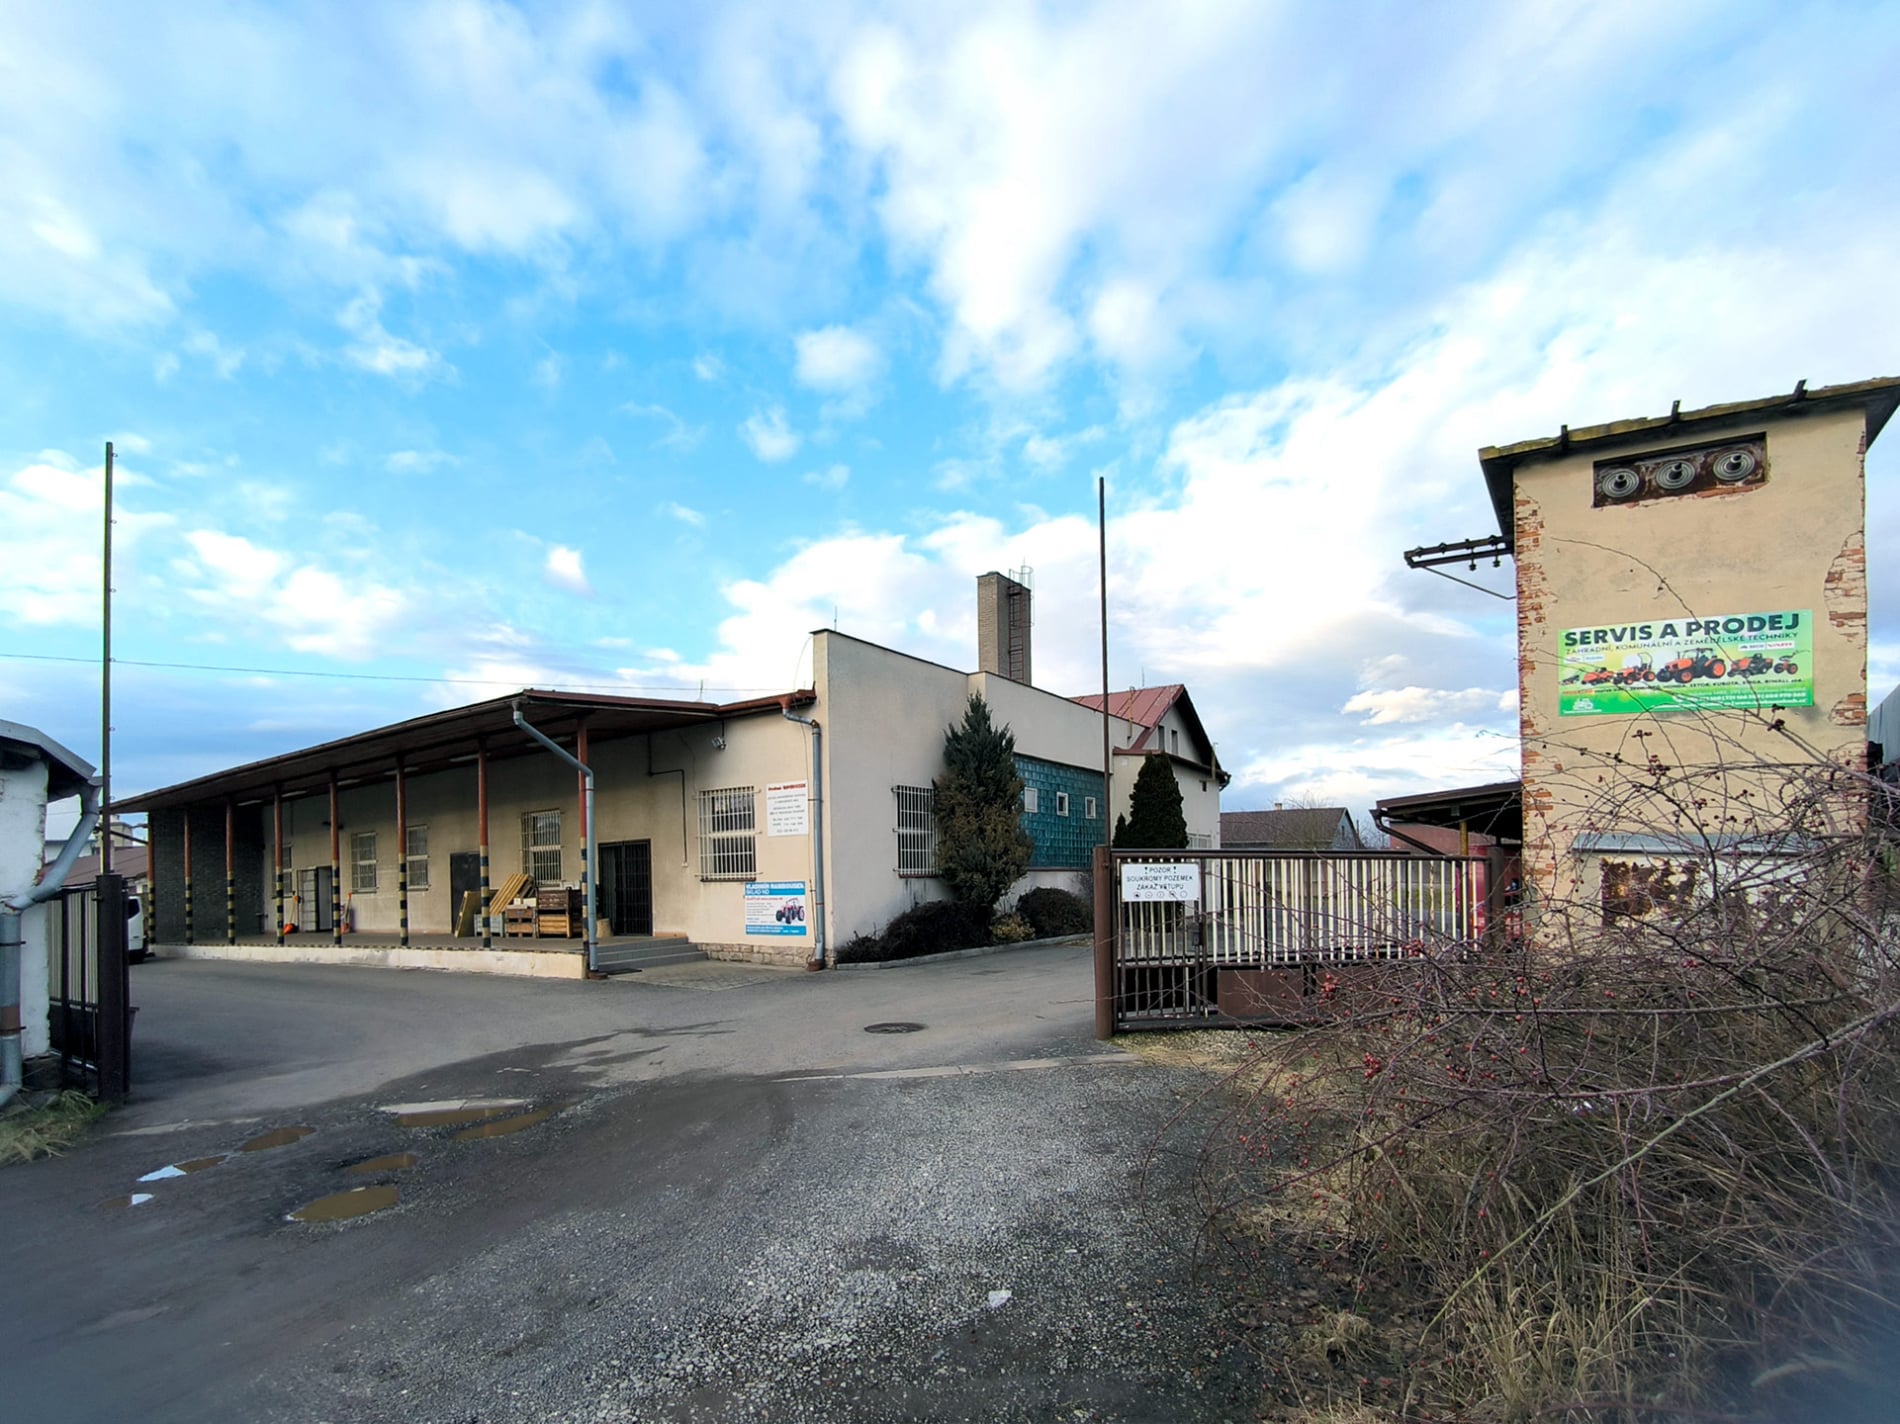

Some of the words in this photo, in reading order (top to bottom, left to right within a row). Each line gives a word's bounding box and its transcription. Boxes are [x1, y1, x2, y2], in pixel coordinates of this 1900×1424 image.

[1564, 625, 1653, 646] SERVIS
[1659, 623, 1679, 639] A
[1686, 613, 1799, 636] PRODEJ
[1747, 631, 1798, 641] TECHNIKY
